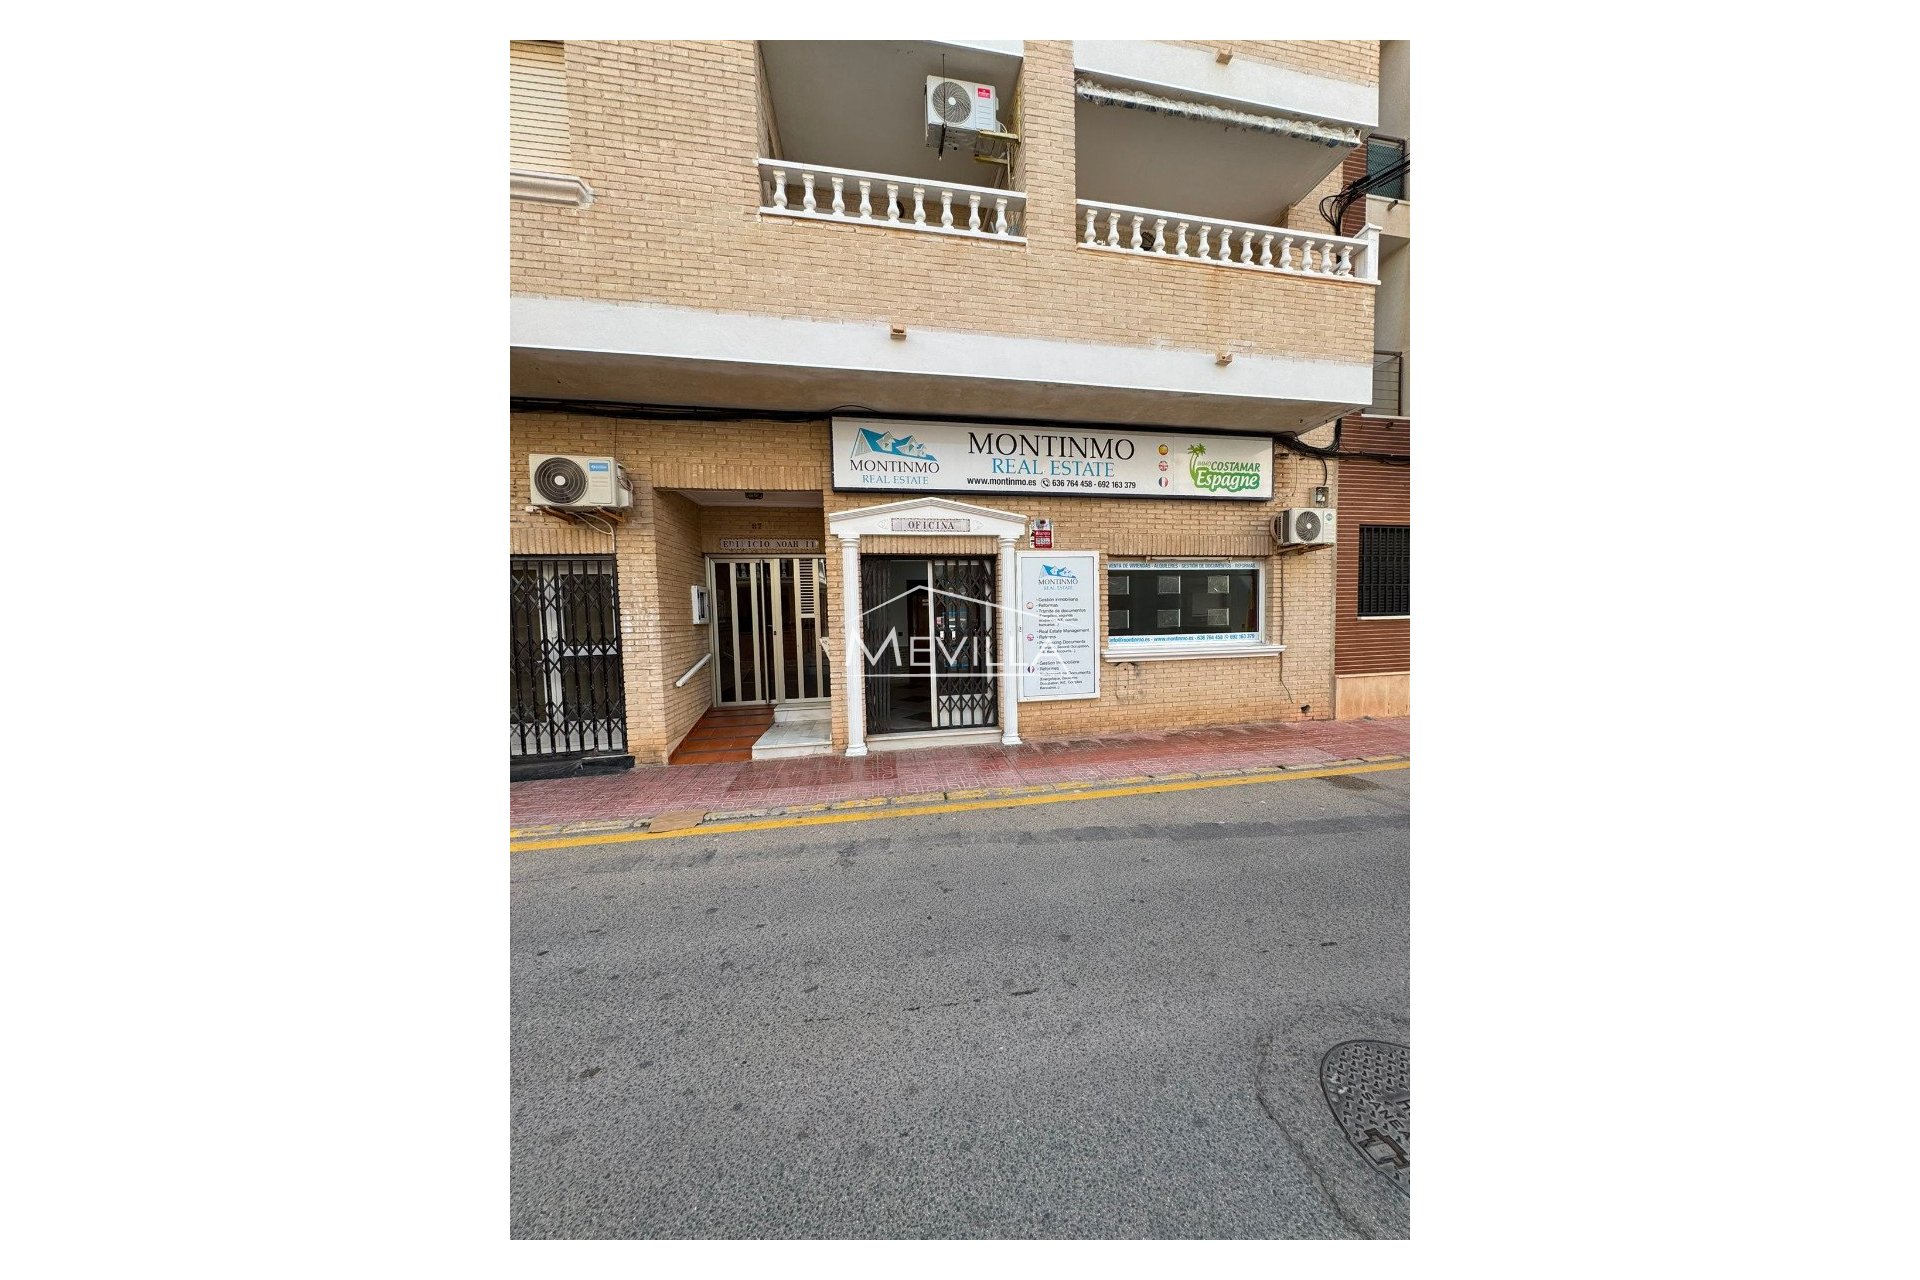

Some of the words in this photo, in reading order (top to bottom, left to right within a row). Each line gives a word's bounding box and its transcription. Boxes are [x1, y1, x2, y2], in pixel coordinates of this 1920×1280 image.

[968, 432, 1135, 460] MONTINMO
[850, 459, 940, 474] MONTINMO
[992, 456, 1043, 474] REAL
[1050, 460, 1115, 477] ESTATE
[1211, 461, 1261, 472] COSTAMAR
[862, 474, 890, 484] REAL
[893, 475, 929, 485] ESTATE
[967, 477, 1037, 486] www.montinmo.es
[1098, 480, 1110, 488] 692
[1197, 469, 1258, 490] Espagne
[908, 521, 954, 530] OFICINA
